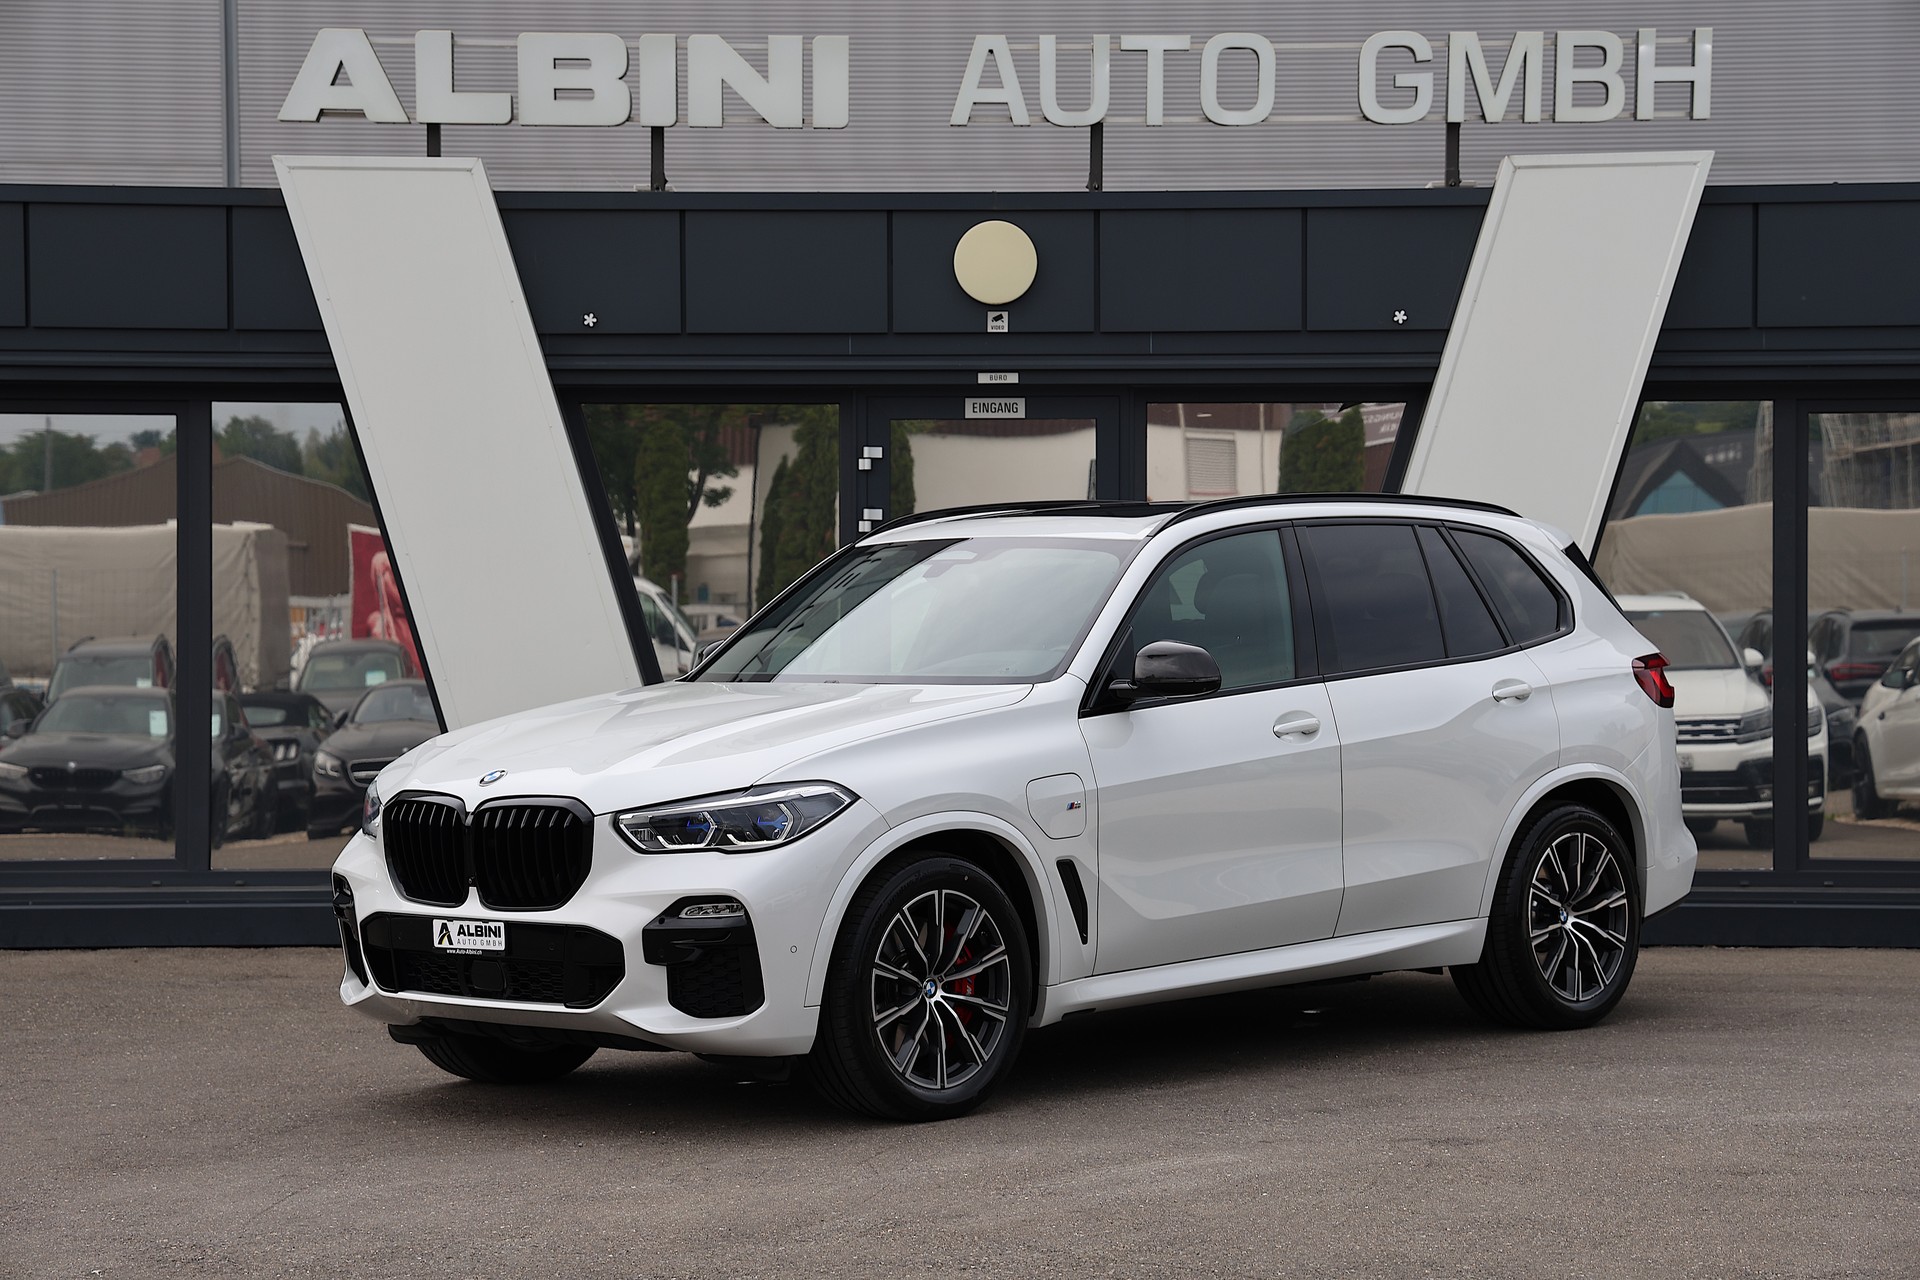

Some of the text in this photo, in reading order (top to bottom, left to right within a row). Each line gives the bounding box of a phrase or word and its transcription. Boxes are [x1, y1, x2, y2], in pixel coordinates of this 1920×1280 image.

[278, 27, 1714, 129] ALBINI AUTO GMBH
[972, 402, 1019, 414] EINGANG
[457, 924, 502, 938] ALBINI
[457, 938, 477, 946] AUTO
